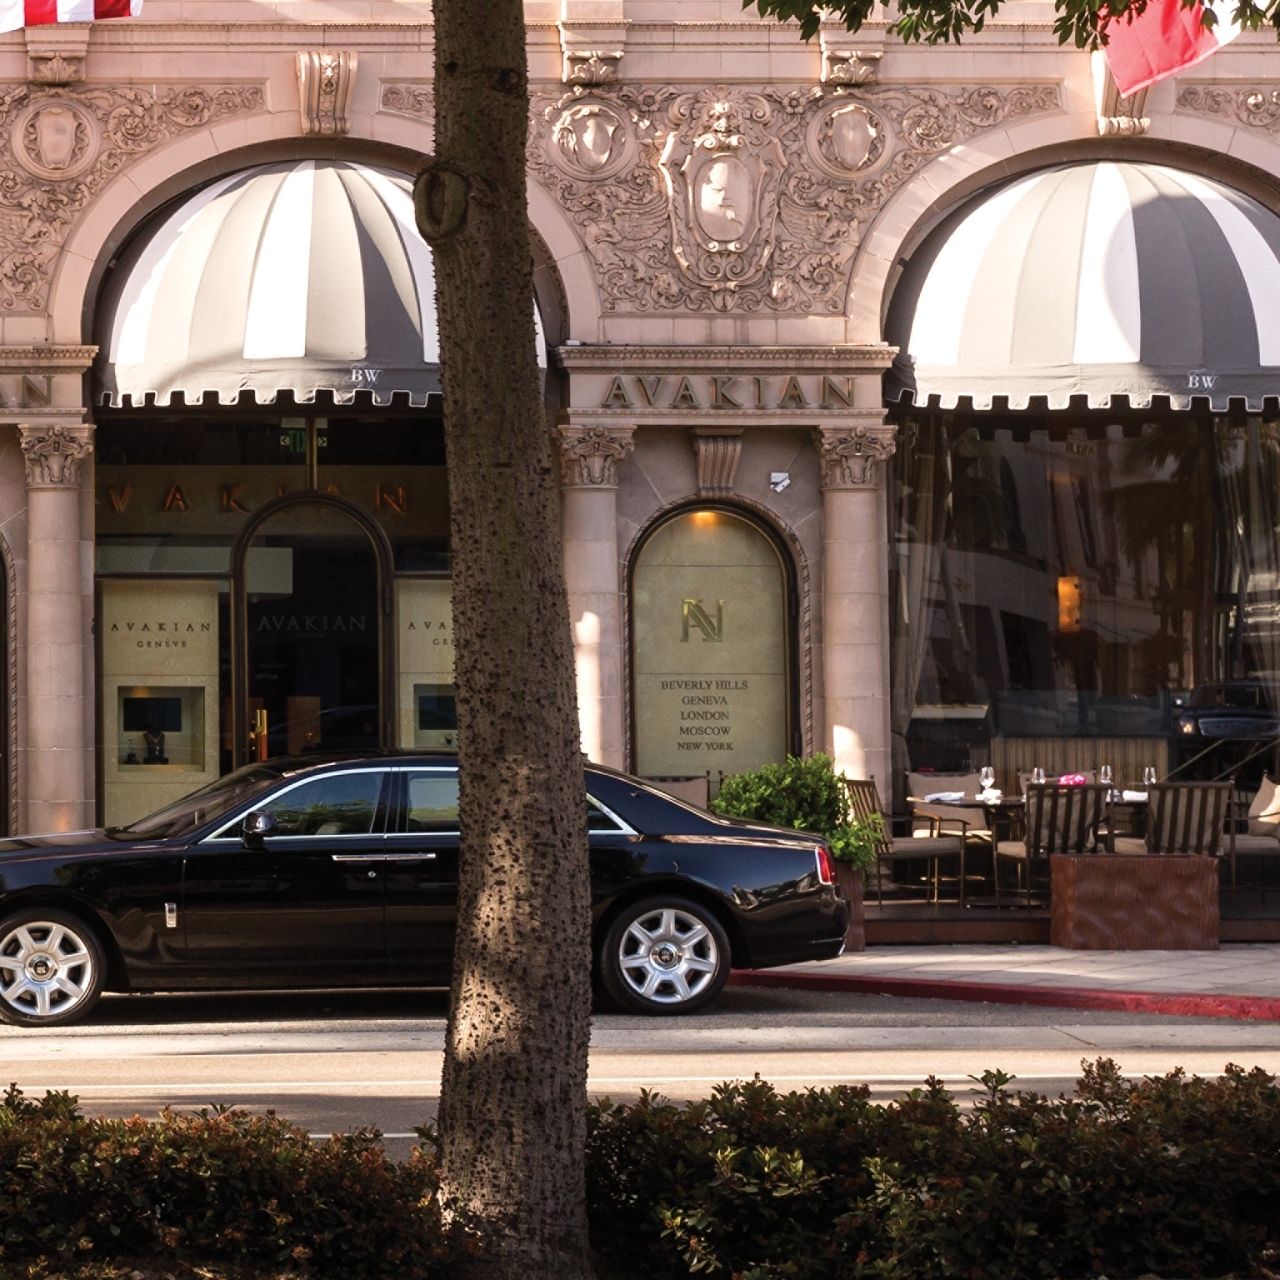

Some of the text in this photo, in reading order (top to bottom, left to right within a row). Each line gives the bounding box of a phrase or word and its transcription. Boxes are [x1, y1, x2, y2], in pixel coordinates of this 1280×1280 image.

[351, 369, 382, 382] BW
[1188, 374, 1219, 389] BW
[600, 375, 858, 409] AVAKIAN
[111, 622, 211, 632] AVAKIAN
[258, 615, 366, 631] AVAKIAN
[661, 680, 749, 690] BEVERLY HILLS
[681, 695, 728, 705] GENEVA
[680, 711, 730, 721] LONDON
[679, 726, 732, 736] MOSCOW
[677, 742, 734, 751] NEW YORK
